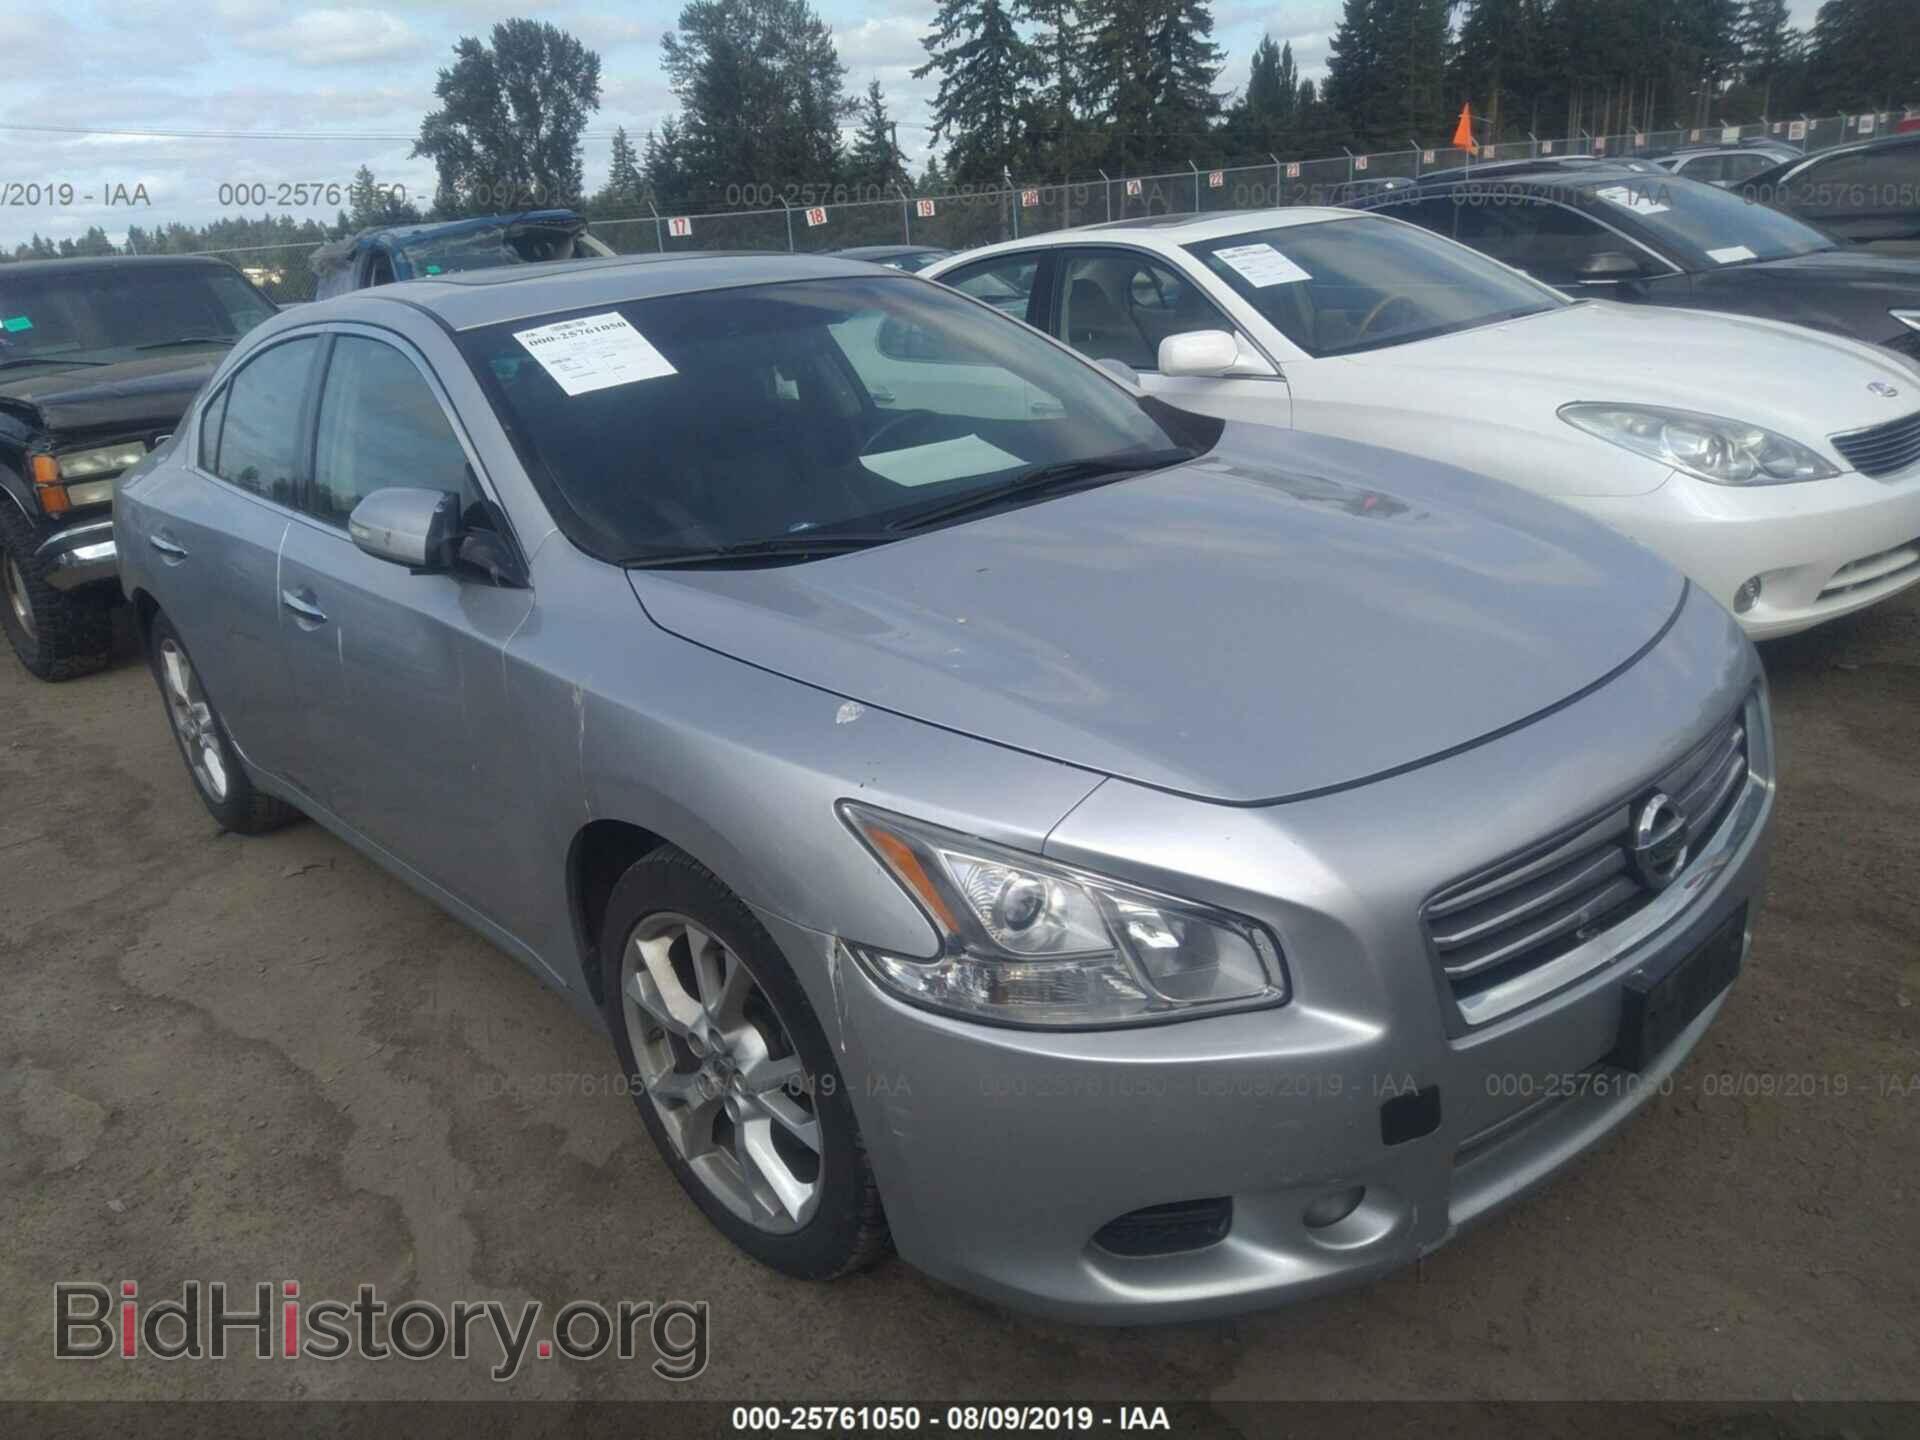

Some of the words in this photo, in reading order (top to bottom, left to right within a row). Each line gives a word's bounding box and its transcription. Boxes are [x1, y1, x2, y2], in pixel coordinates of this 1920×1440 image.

[809, 207, 824, 226] 18
[920, 201, 933, 217] 19
[672, 217, 687, 236] 17
[528, 320, 627, 347] 000-25761050
